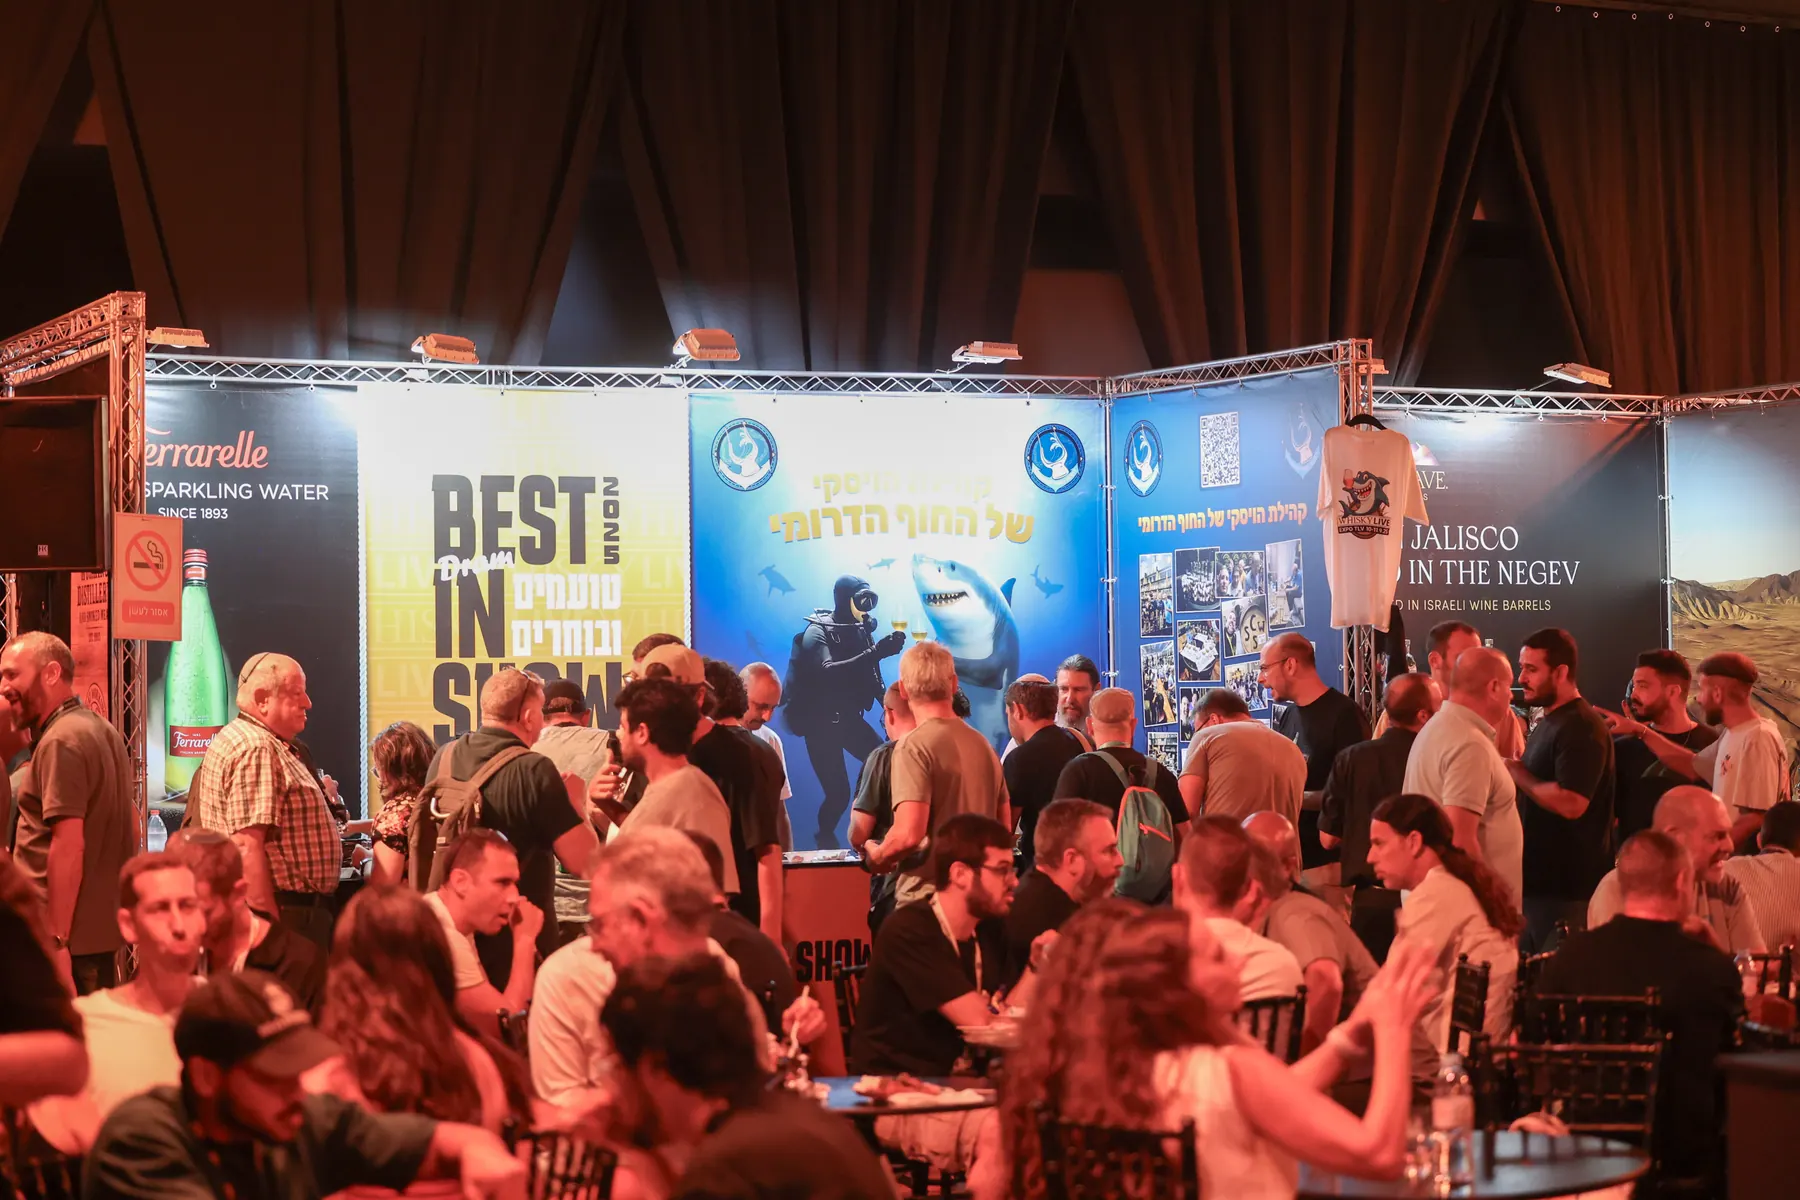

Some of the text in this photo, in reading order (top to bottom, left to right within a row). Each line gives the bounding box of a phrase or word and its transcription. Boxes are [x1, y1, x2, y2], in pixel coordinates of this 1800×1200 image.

[145, 424, 269, 469] errarelle
[144, 482, 329, 500] SPARKLING WATER
[158, 507, 228, 519] SINCE 1893
[432, 474, 596, 565] BEST
[602, 476, 620, 565] 2025
[769, 502, 1036, 544] של החוף הדרומי
[1138, 501, 1308, 533] קהילת הויסקי של החוף הדרומי
[1338, 516, 1391, 526] WHISKY LIVE
[1410, 525, 1519, 550] JALISCO
[438, 550, 515, 581] Dram
[1409, 560, 1433, 584] IN
[1440, 560, 1490, 585] THE
[1498, 560, 1580, 585] NEGEV
[77, 582, 108, 606] DISTILLER
[513, 573, 622, 611] טועמים
[1408, 600, 1419, 611] IN
[1424, 600, 1466, 611] ISRAELI
[1469, 600, 1499, 611] WINE
[1503, 600, 1551, 611] BARRELS
[128, 605, 168, 618] אסור לעשן
[433, 568, 506, 659] IN
[511, 619, 622, 657] ובוחרים
[433, 661, 622, 745] SW
[173, 731, 217, 749] Ferrarel
